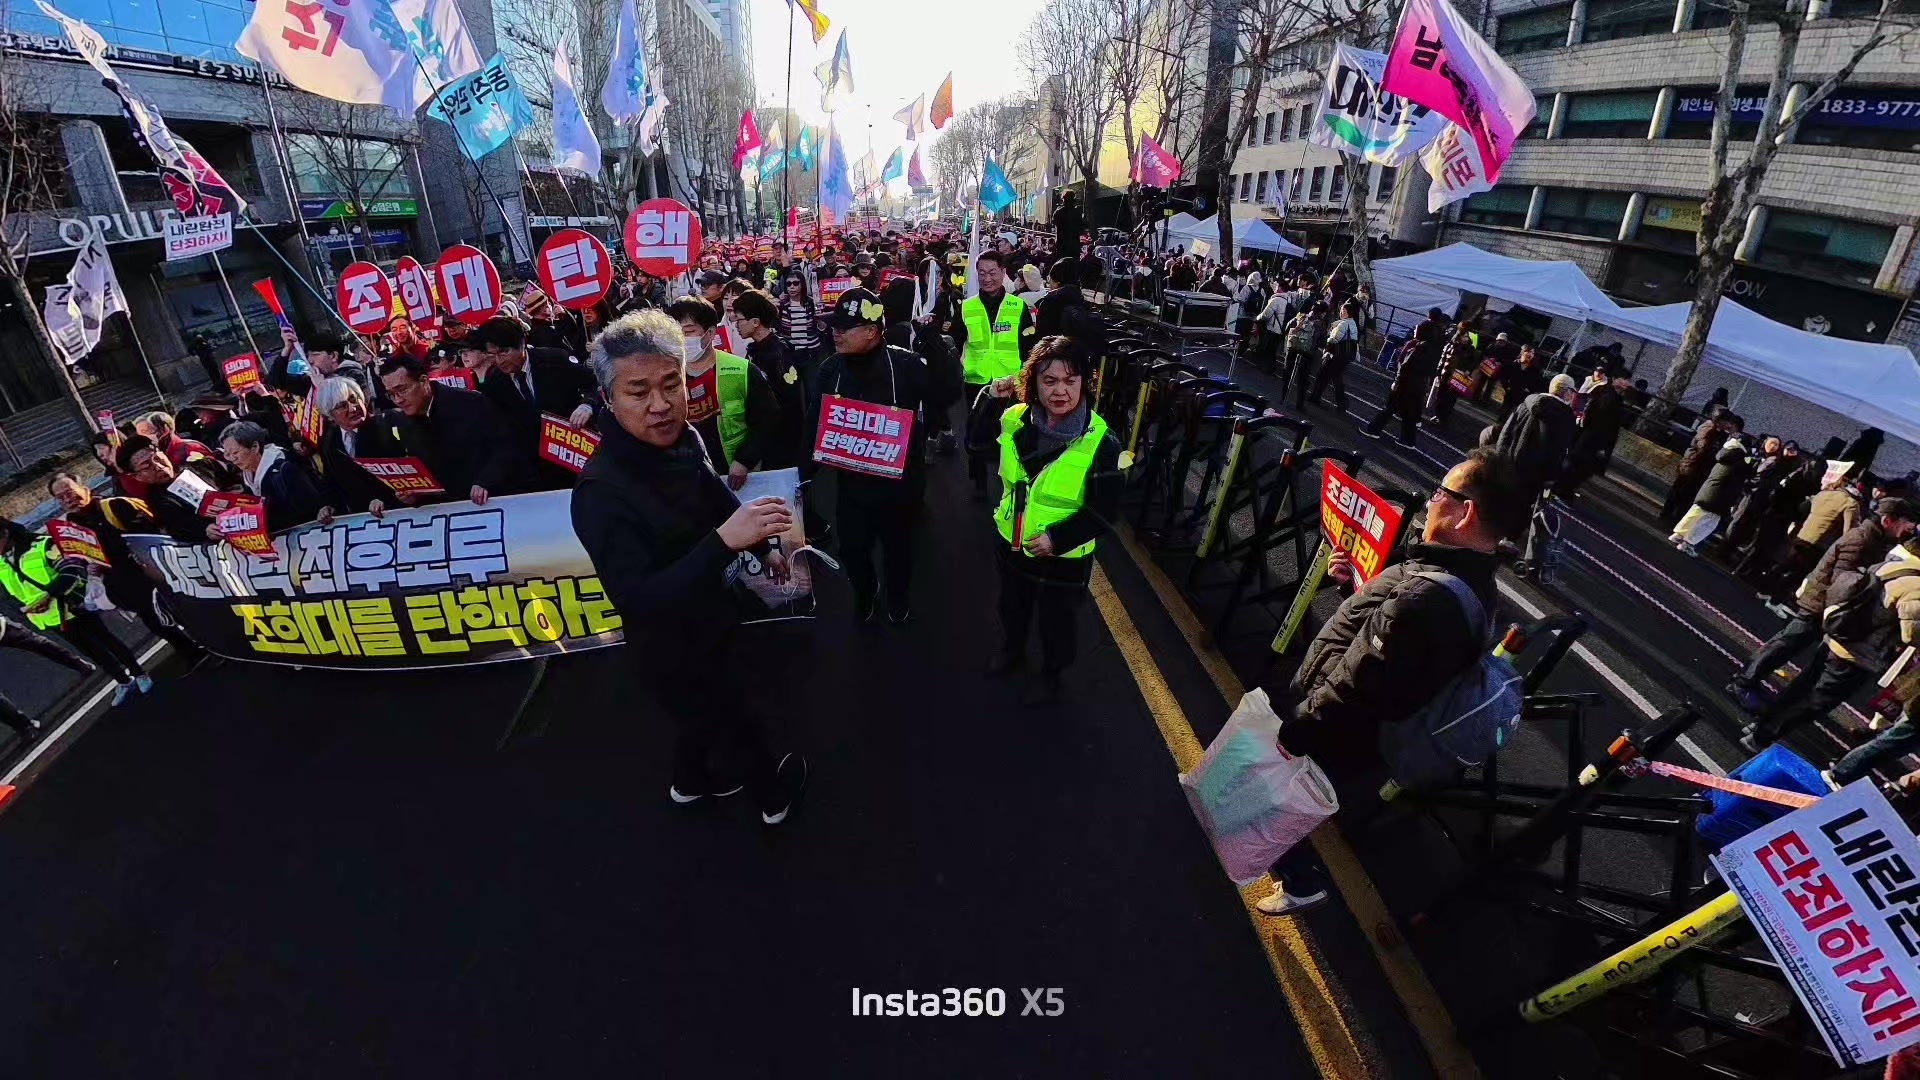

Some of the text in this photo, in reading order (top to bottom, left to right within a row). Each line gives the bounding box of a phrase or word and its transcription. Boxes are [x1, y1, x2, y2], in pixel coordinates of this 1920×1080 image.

[170, 218, 225, 236] 내란완전
[170, 230, 228, 251] 단죄하자!
[635, 210, 690, 265] 핵
[398, 265, 432, 321] 희
[441, 256, 493, 315] 대
[546, 238, 601, 302] 탄
[346, 271, 387, 326] 조
[820, 430, 901, 463] 탄핵하라!
[827, 405, 900, 438] 조희대를
[1326, 473, 1385, 543] 조희대를
[1322, 501, 1379, 580] 탄핵하라!
[1298, 548, 1327, 597] OLICE
[231, 597, 407, 657] 조희대를
[1601, 924, 1700, 983] POLICE
[1753, 829, 1920, 1042] 단죄하자!
